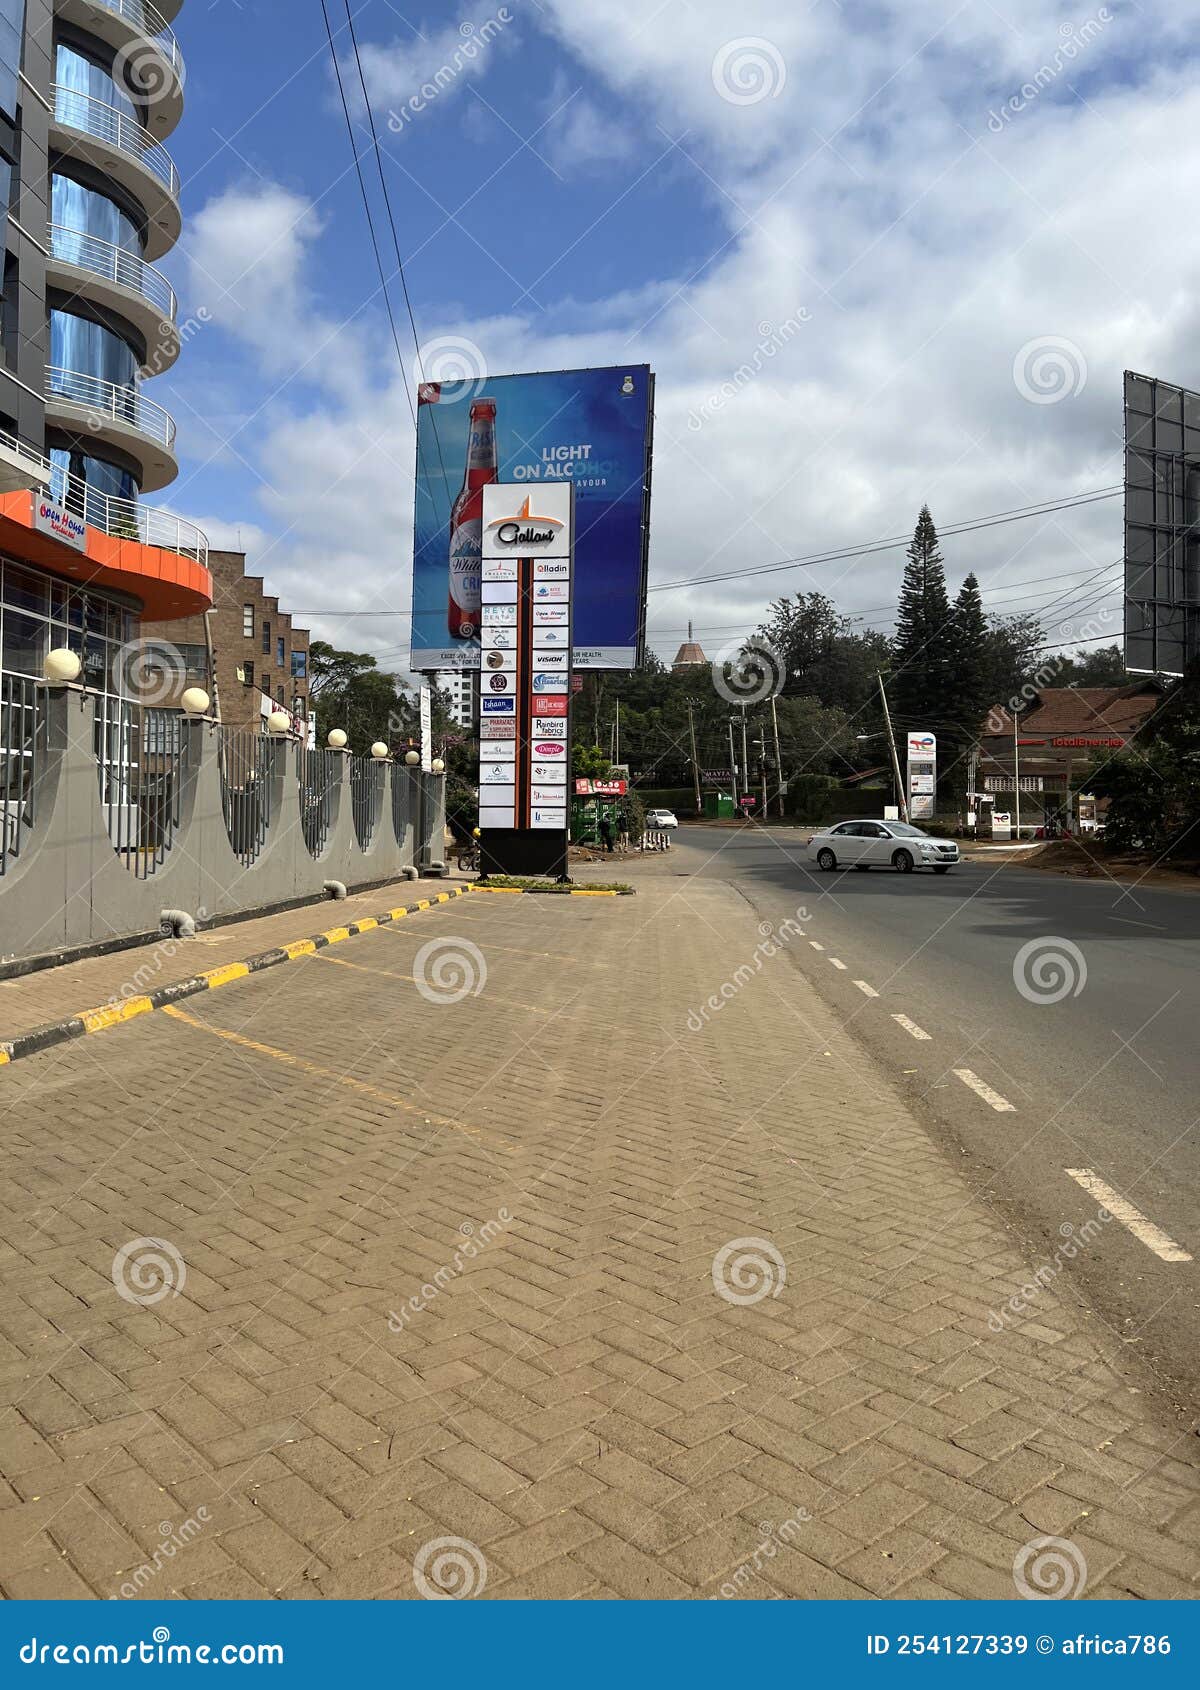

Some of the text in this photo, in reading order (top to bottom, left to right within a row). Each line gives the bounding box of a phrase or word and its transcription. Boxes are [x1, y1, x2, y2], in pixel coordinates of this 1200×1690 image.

[542, 445, 592, 462] LIGHT
[513, 461, 619, 480] ON ALCOHO
[573, 478, 606, 488] AVOUR
[40, 503, 60, 522] Open
[498, 523, 555, 545] Gallant
